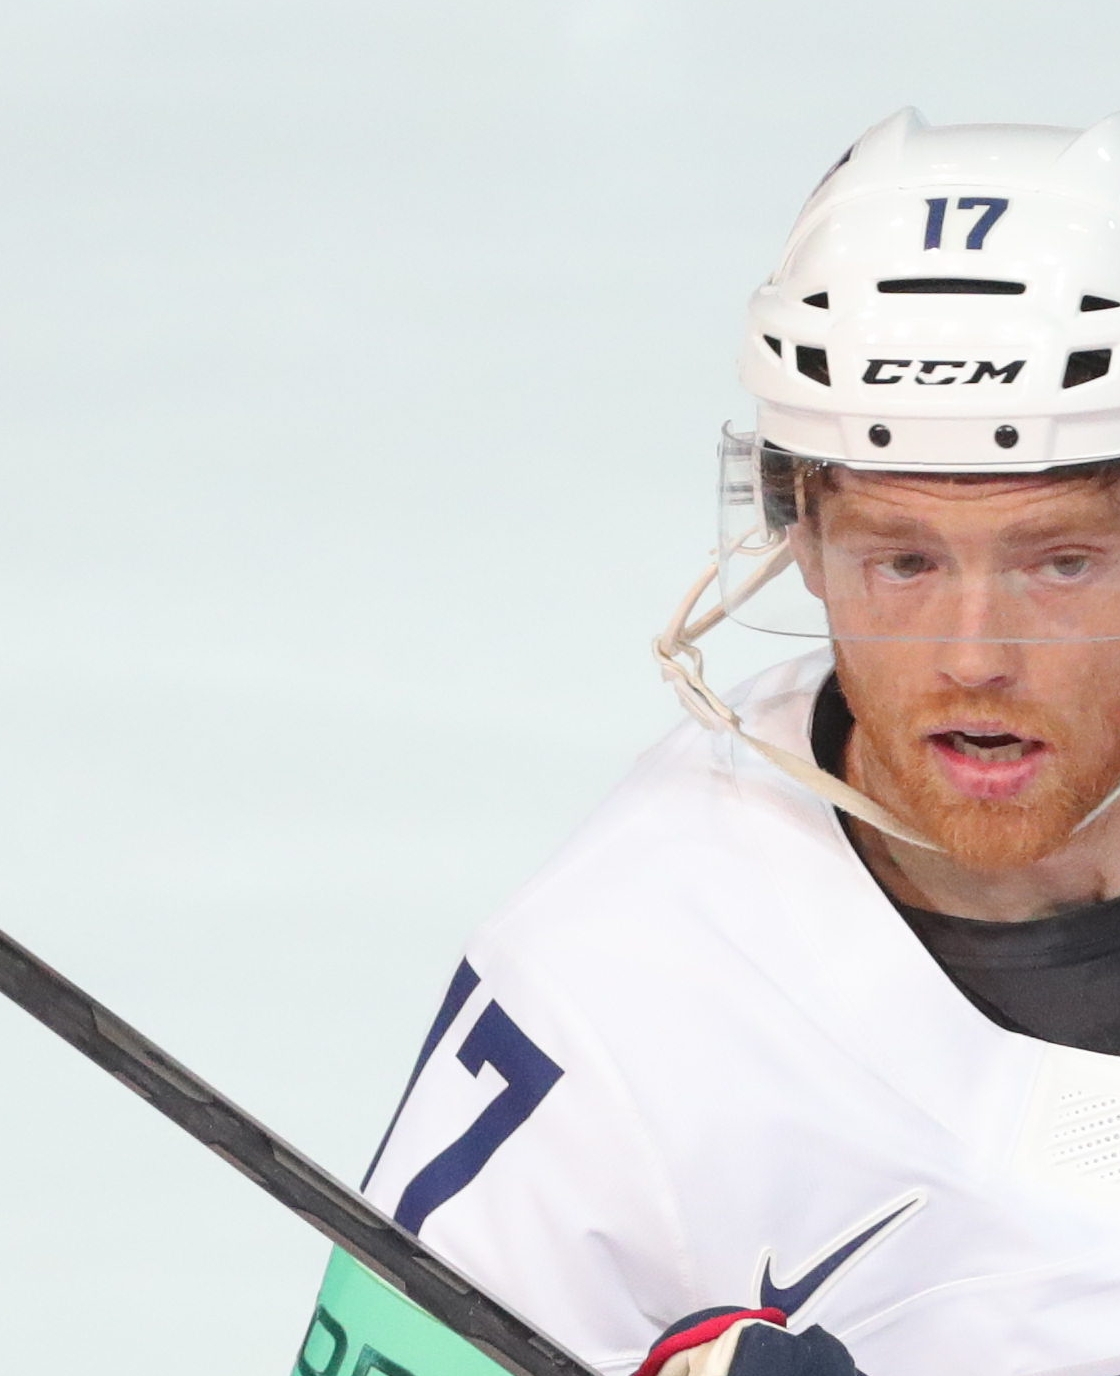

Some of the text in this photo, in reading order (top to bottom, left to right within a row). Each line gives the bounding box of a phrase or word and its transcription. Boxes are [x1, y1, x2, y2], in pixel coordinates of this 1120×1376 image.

[923, 197, 1010, 251] 17
[861, 359, 1027, 386] CCM
[359, 955, 565, 1238] 17
